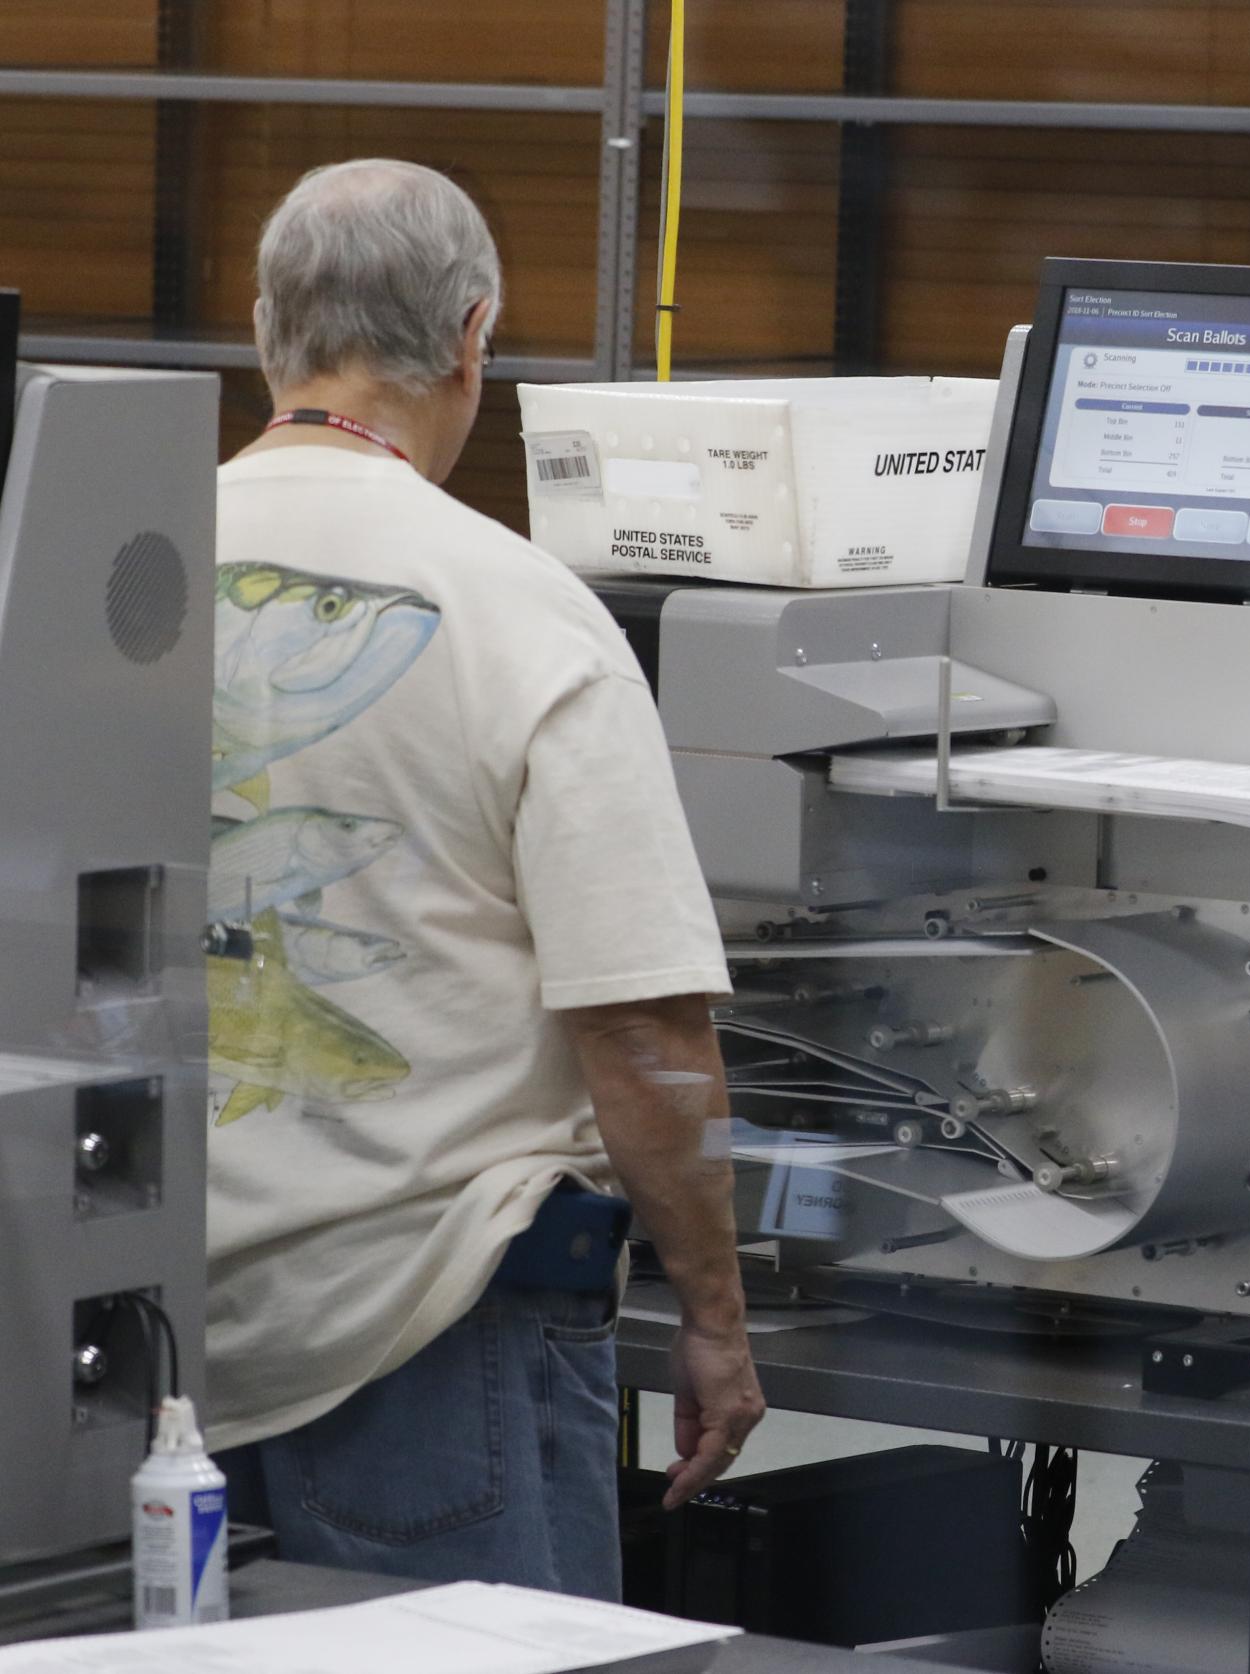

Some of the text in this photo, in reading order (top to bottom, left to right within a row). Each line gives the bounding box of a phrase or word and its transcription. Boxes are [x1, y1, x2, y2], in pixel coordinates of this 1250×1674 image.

[1166, 326, 1247, 346] Scan Ballots
[1103, 352, 1137, 364] Scanning
[707, 448, 769, 461] TARE WEIGHT
[723, 460, 756, 471] 1.0 LBS
[873, 449, 986, 477] UNITED STAT
[1128, 515, 1148, 529] Stop
[613, 529, 704, 548] UNITED STATES
[611, 544, 713, 564] POSTAL SERVICE
[848, 545, 886, 556] WARNING
